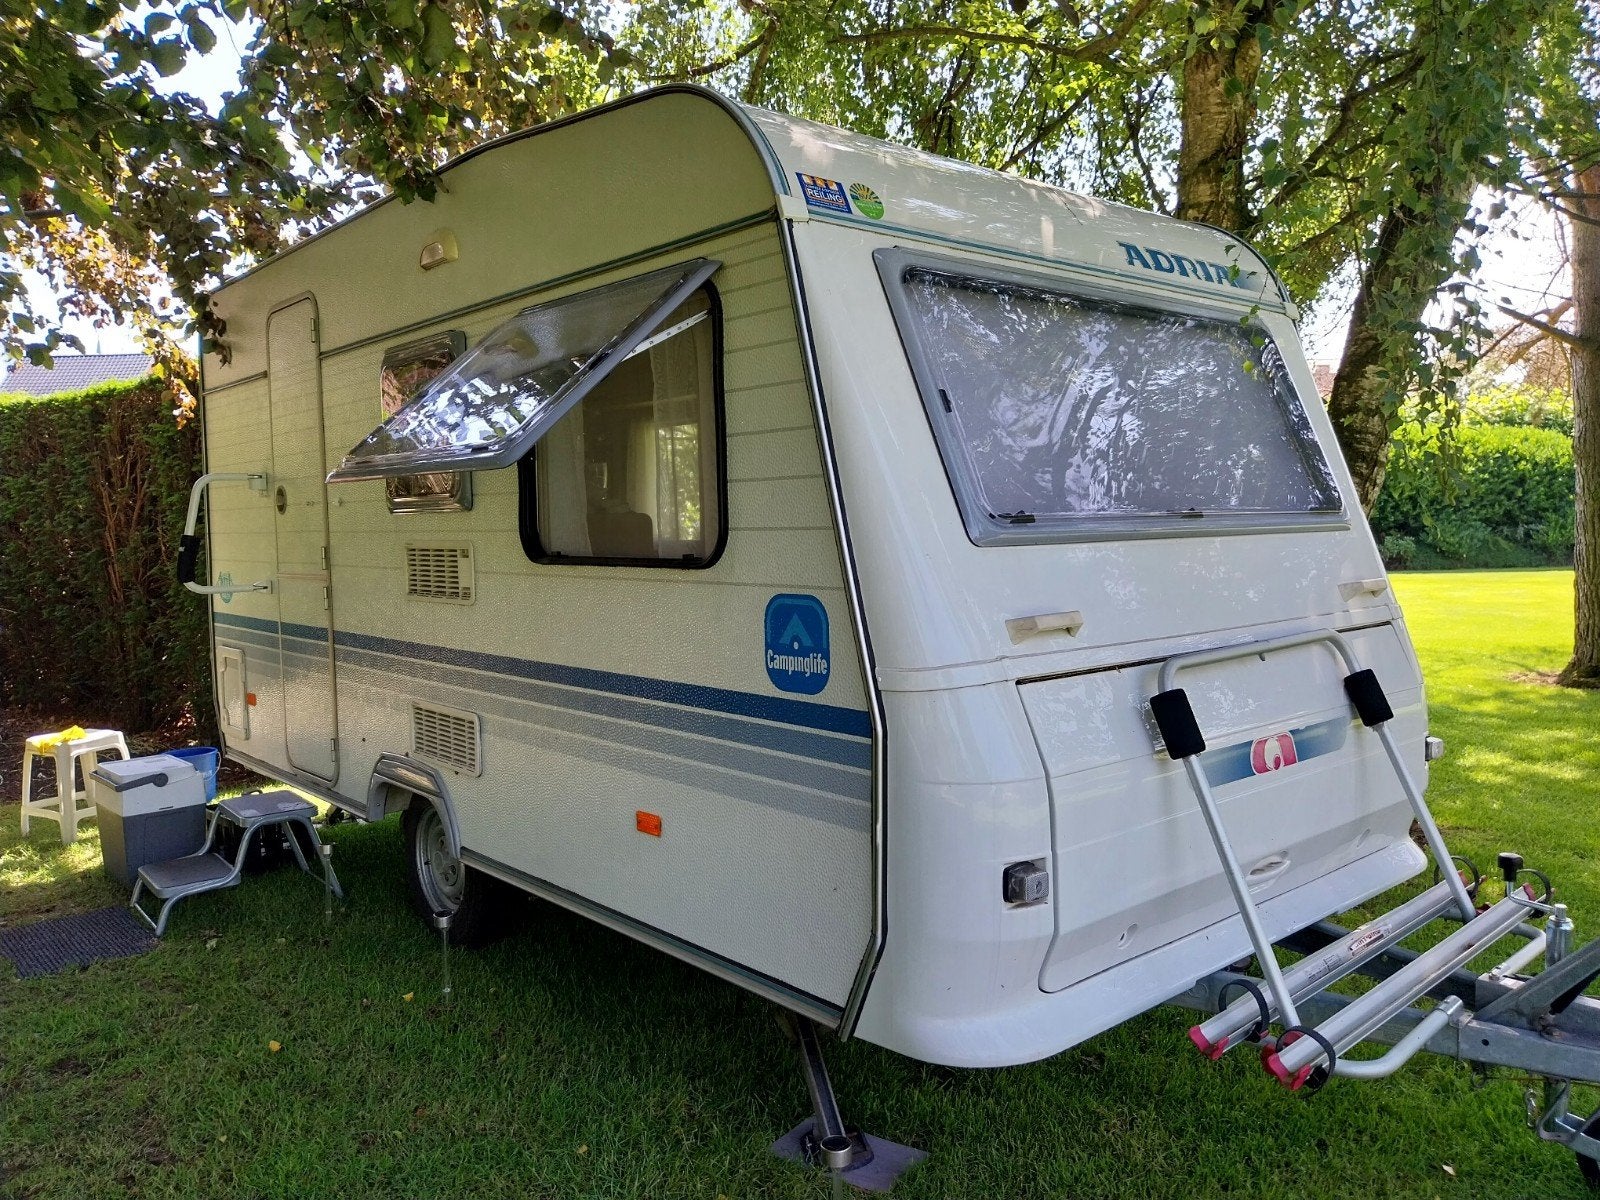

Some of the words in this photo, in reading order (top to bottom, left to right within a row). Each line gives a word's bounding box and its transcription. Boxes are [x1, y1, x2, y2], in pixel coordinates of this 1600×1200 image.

[806, 187, 843, 203] REILING
[1116, 240, 1240, 288] ADRIA
[767, 649, 828, 677] Campinglife
